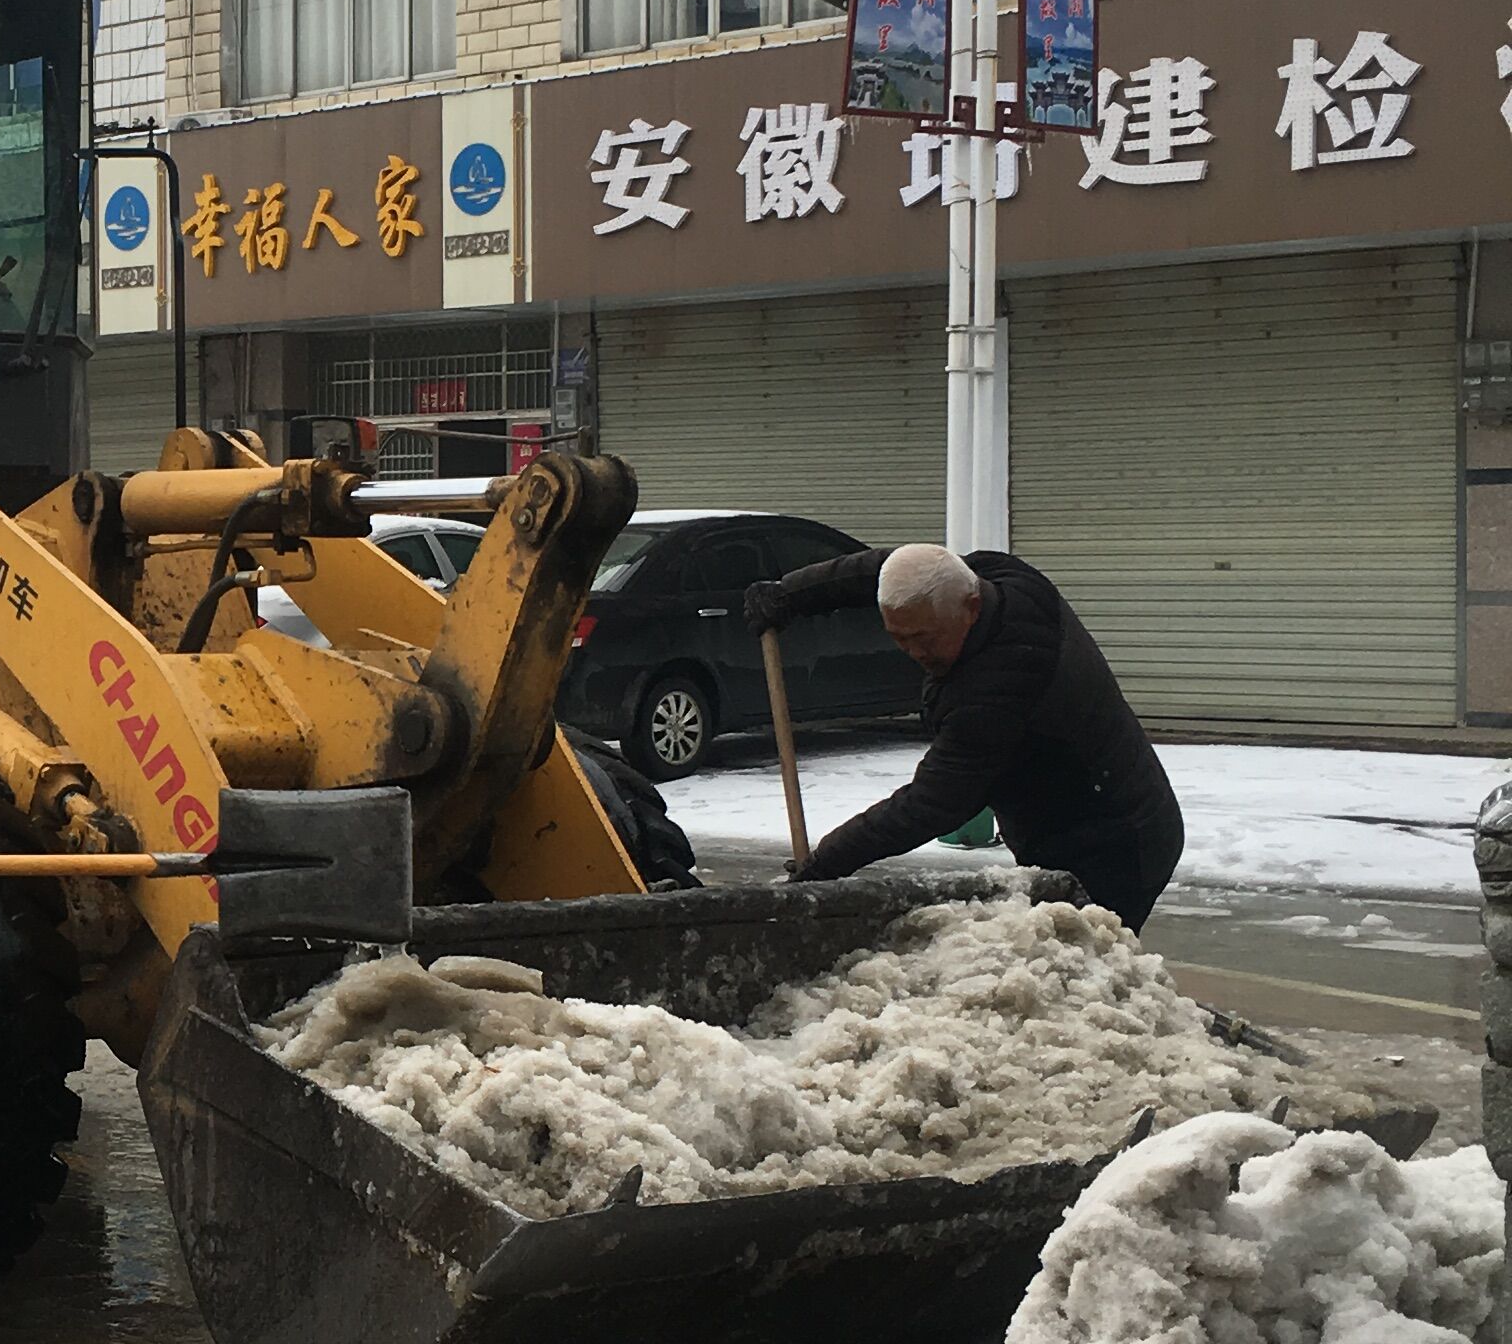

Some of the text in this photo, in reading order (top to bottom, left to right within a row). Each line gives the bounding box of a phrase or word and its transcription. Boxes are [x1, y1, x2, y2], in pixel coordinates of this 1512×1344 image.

[588, 18, 1512, 236] 安徽建检
[181, 154, 426, 279] 幸福人家
